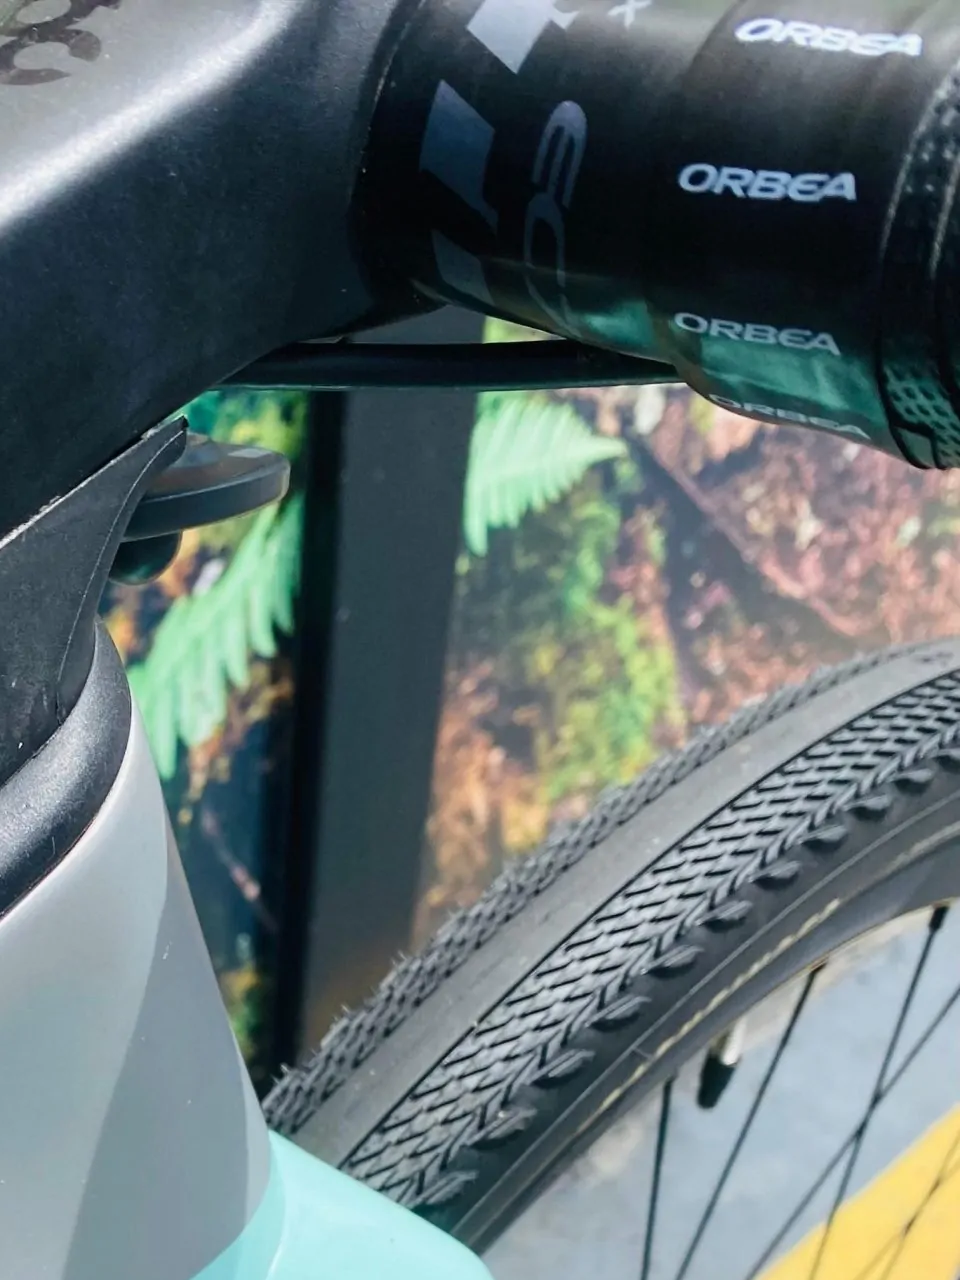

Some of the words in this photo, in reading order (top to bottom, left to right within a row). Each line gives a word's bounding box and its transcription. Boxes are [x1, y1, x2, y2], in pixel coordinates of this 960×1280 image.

[735, 18, 923, 57] ORBEA
[677, 163, 857, 201] ORBEA
[673, 312, 841, 356] ORBEA
